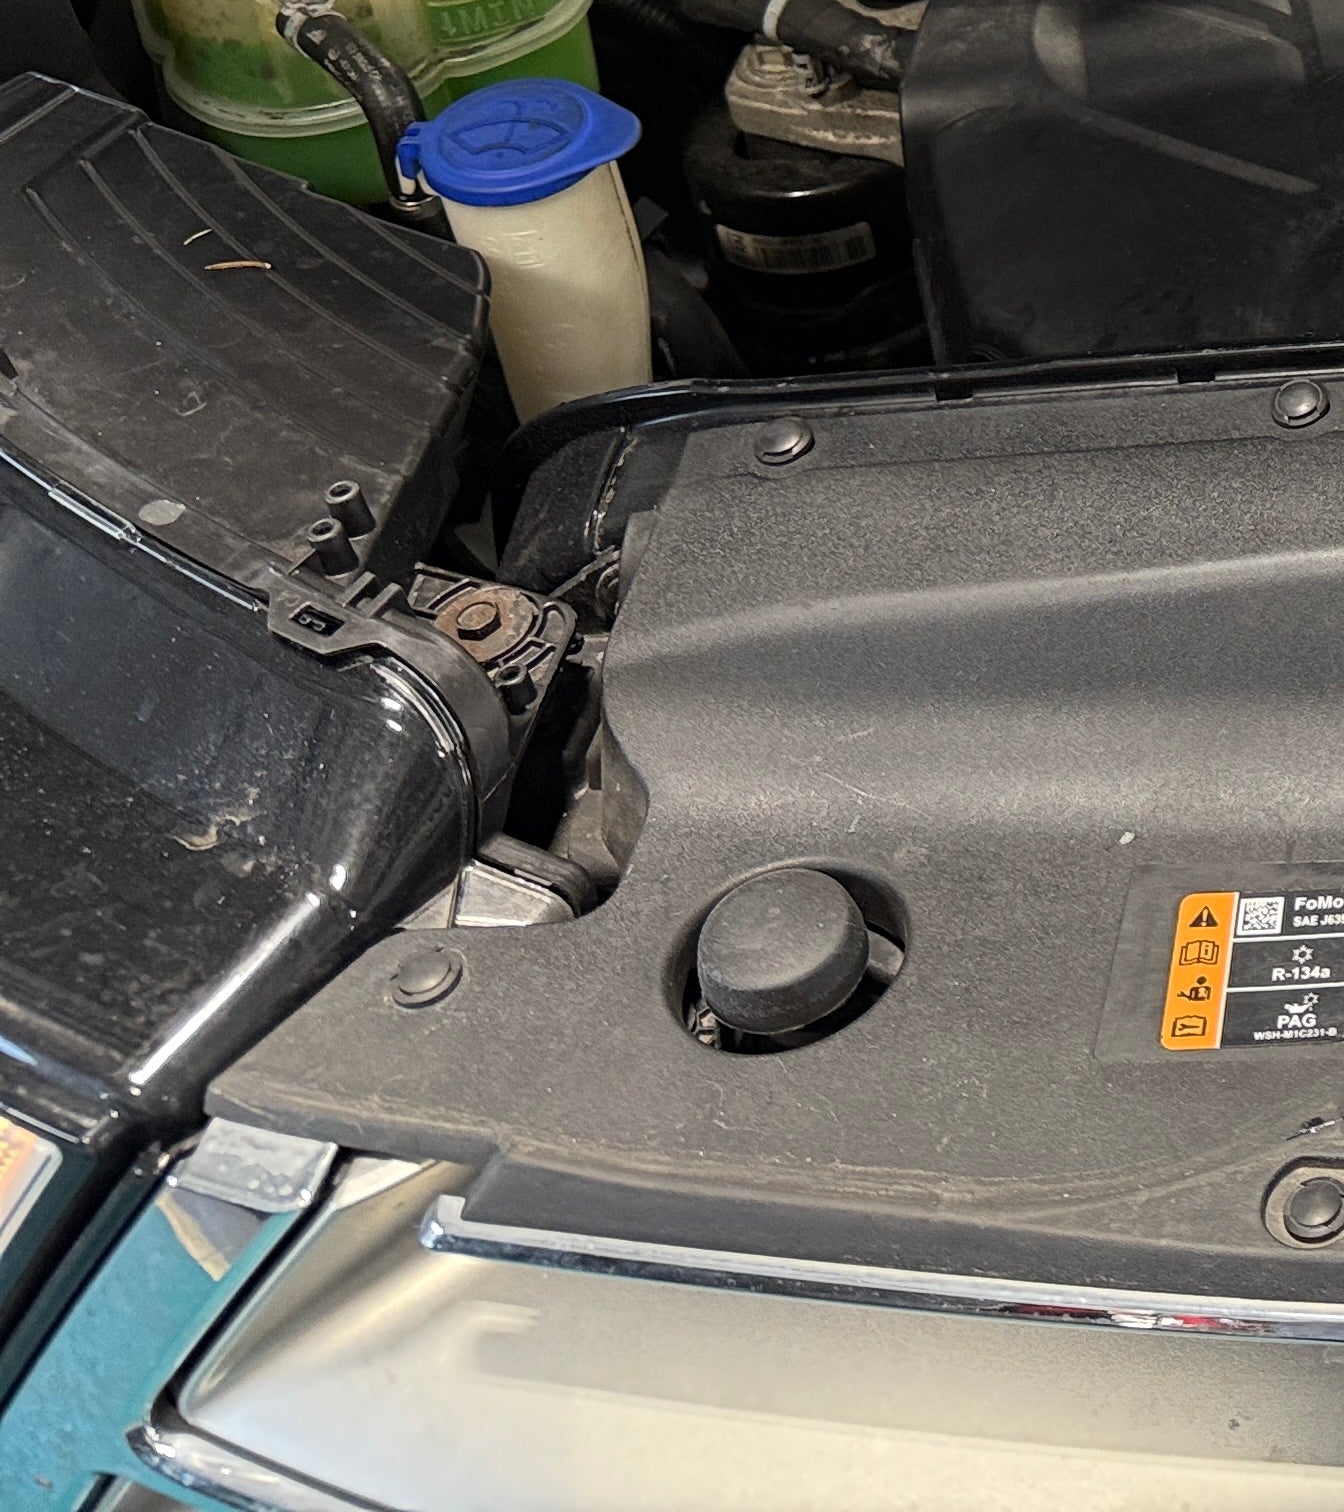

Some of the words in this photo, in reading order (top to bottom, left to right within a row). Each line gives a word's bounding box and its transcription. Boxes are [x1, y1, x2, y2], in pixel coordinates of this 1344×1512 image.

[1293, 915, 1318, 928] SAE
[1272, 966, 1330, 981] R-134a
[1277, 1013, 1317, 1029] PAG
